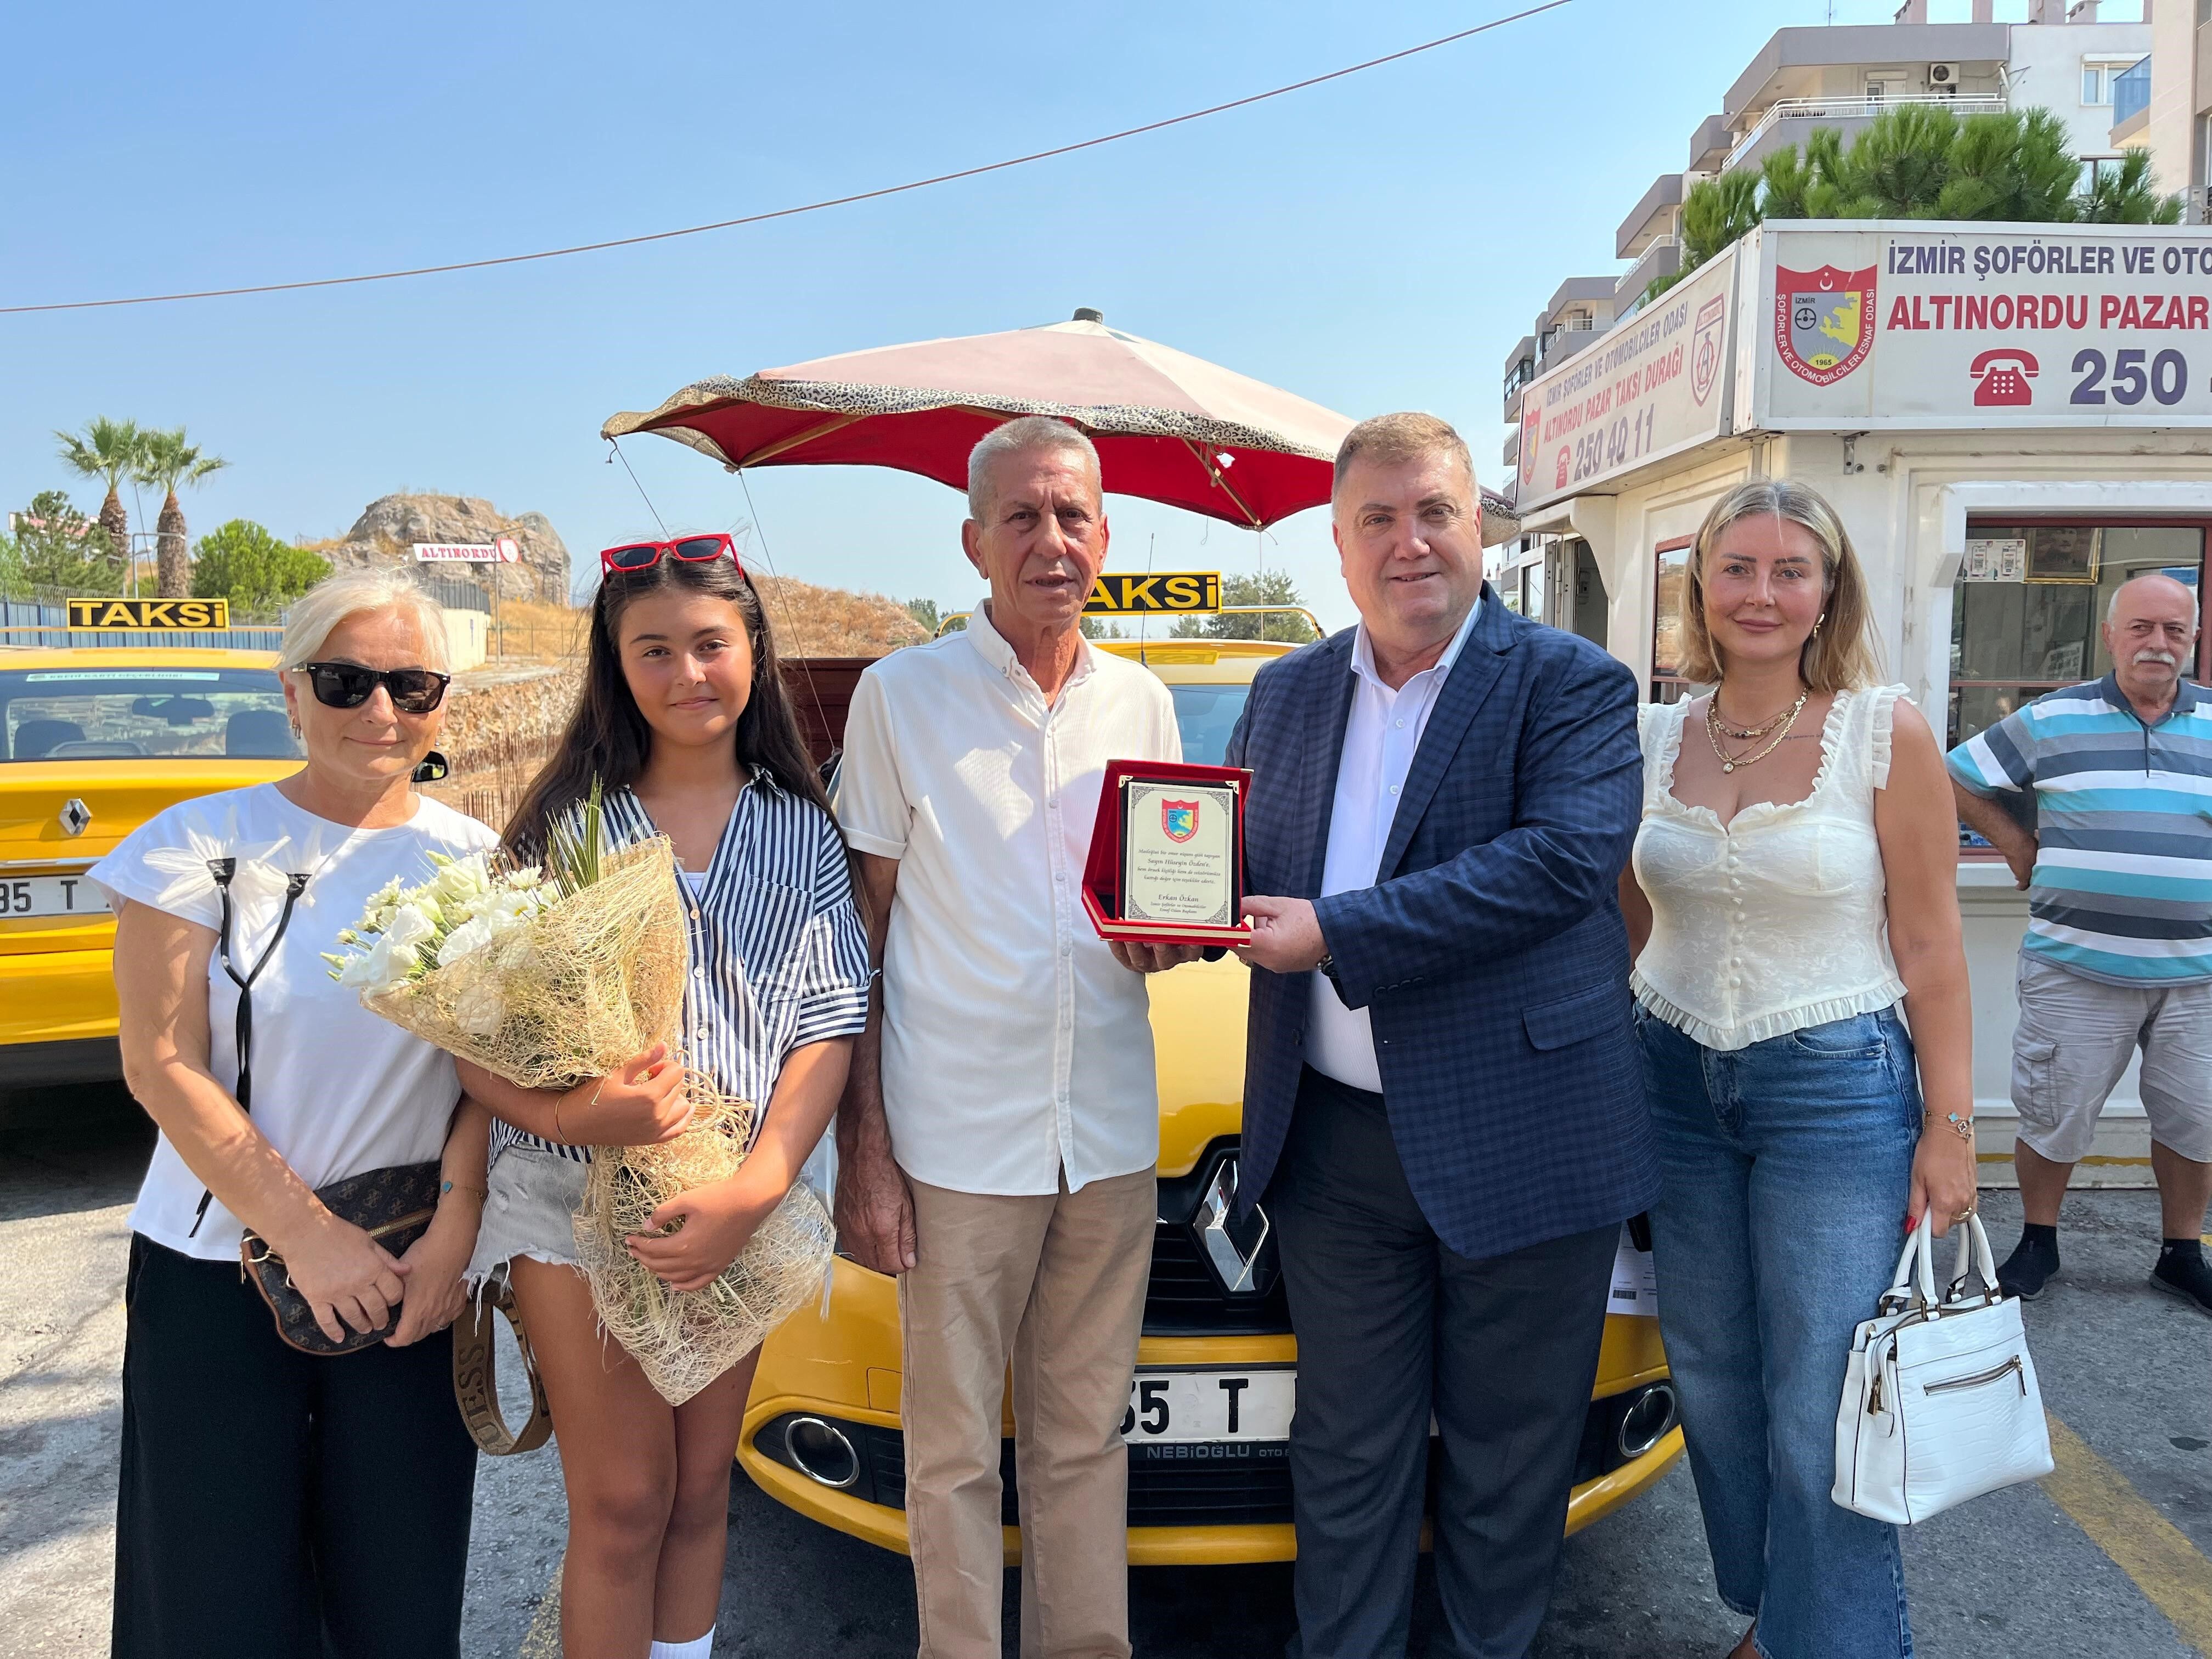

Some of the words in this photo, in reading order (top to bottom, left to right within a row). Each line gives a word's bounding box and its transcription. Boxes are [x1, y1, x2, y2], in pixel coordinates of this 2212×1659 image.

[1888, 240, 1966, 274] İZMİR
[1973, 239, 2114, 281] ŞOFÖRLER
[2122, 246, 2155, 274] VE
[2163, 246, 2212, 275] OTO
[1776, 294, 1787, 348] ŞOFÖRLER
[1783, 348, 1793, 362] VE
[1791, 354, 1861, 383] OTOMOBİLCİLER
[1858, 323, 1874, 356] ESNAF
[1866, 289, 1875, 320] ODASI
[1887, 294, 2088, 330] ALTINORDU
[2100, 295, 2209, 330] PAZAR
[1595, 357, 1603, 380] VE
[1663, 301, 1688, 338] ODASI
[2070, 348, 2188, 405] 250
[1544, 402, 1583, 444] ALTINORDU
[1585, 387, 1611, 423] PAZAR
[1574, 428, 1603, 482] 250
[1607, 416, 1628, 466] 40
[422, 547, 495, 558] ALTINORDU
[60, 880, 78, 910] T
[1219, 1379, 1249, 1433] T
[1259, 1449, 1283, 1457] OTO
